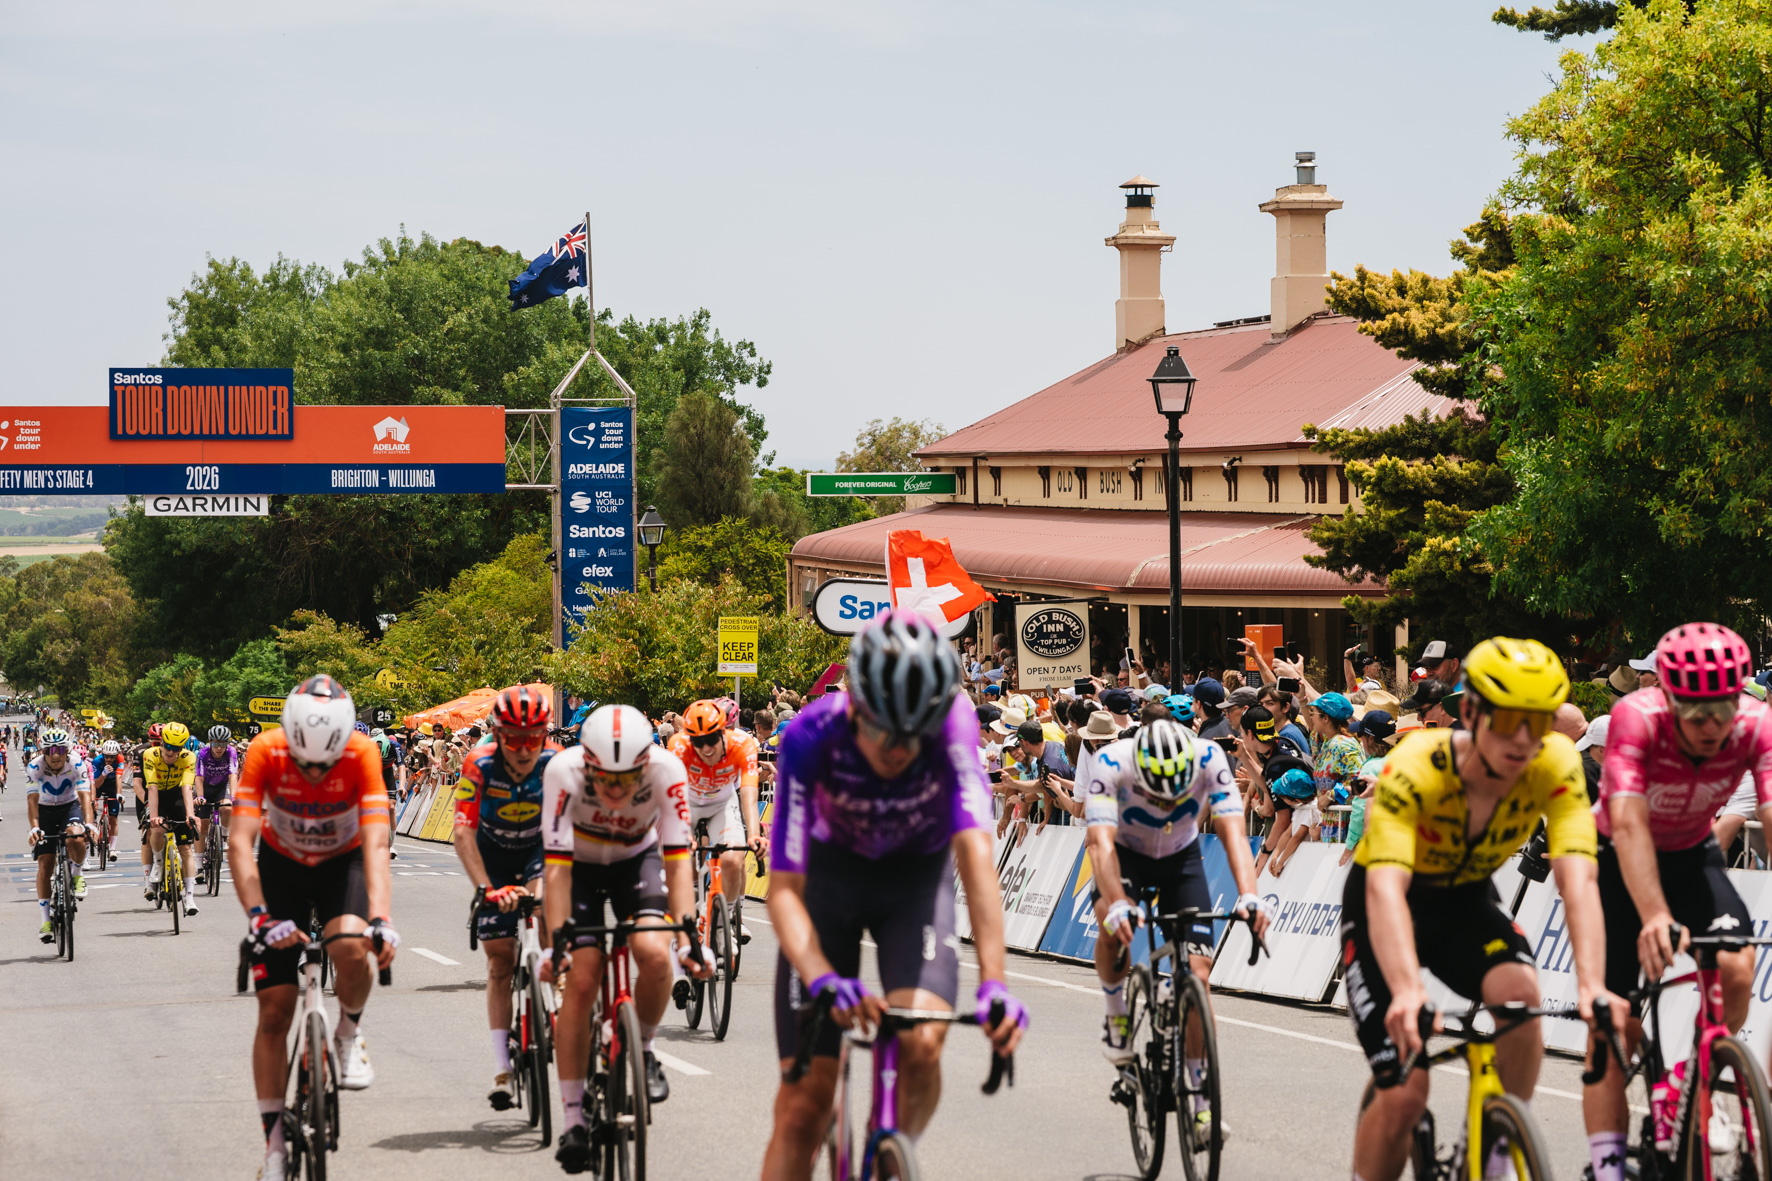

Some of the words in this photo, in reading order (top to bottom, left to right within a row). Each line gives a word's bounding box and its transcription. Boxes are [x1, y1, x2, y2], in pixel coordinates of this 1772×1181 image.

[114, 372, 162, 384] Santos
[114, 386, 163, 435] TOUR
[166, 386, 224, 435] DOWN
[228, 386, 289, 435] UNDER
[568, 464, 625, 474] ADELAIDE
[24, 470, 54, 488] MEN'S
[56, 470, 84, 488] STAGE
[86, 470, 93, 488] 4
[186, 466, 219, 490] 2026
[331, 469, 379, 488] BRIGHTON
[388, 469, 436, 488] WILLUNGA
[904, 476, 932, 492] Coopers
[1058, 471, 1072, 492] OLD
[1100, 471, 1122, 494] BUSH
[1155, 471, 1164, 494] IN
[153, 496, 260, 512] GARMIN
[569, 525, 625, 538] Santos
[582, 564, 613, 577] efex
[839, 594, 890, 620] San
[1028, 614, 1048, 633] OLD
[1052, 613, 1080, 632] BUSH
[1043, 624, 1064, 632] INN
[723, 642, 754, 651] KEEP
[1038, 646, 1071, 655] WILLUNGA
[722, 652, 754, 661] CLEAR
[1060, 665, 1082, 674] DAYS
[377, 711, 391, 721] 25
